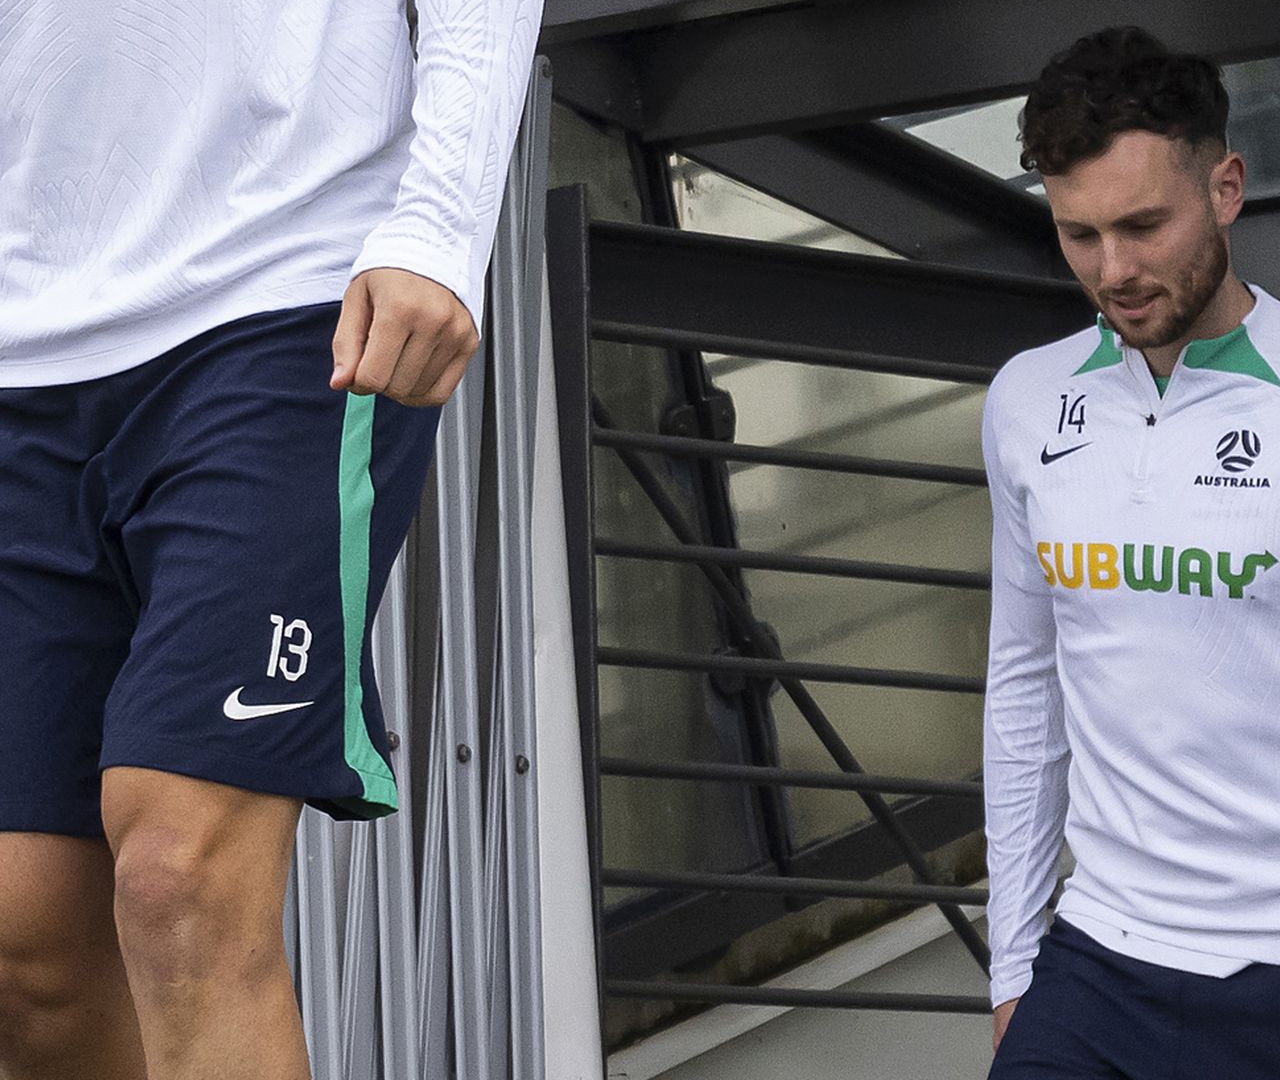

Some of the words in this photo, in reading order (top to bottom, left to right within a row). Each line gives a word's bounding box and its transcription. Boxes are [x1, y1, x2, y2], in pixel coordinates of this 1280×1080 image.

[1057, 394, 1087, 434] 14
[1193, 474, 1271, 489] AUSTRALIA
[1036, 541, 1280, 600] SUBWAY
[266, 614, 314, 682] 13
